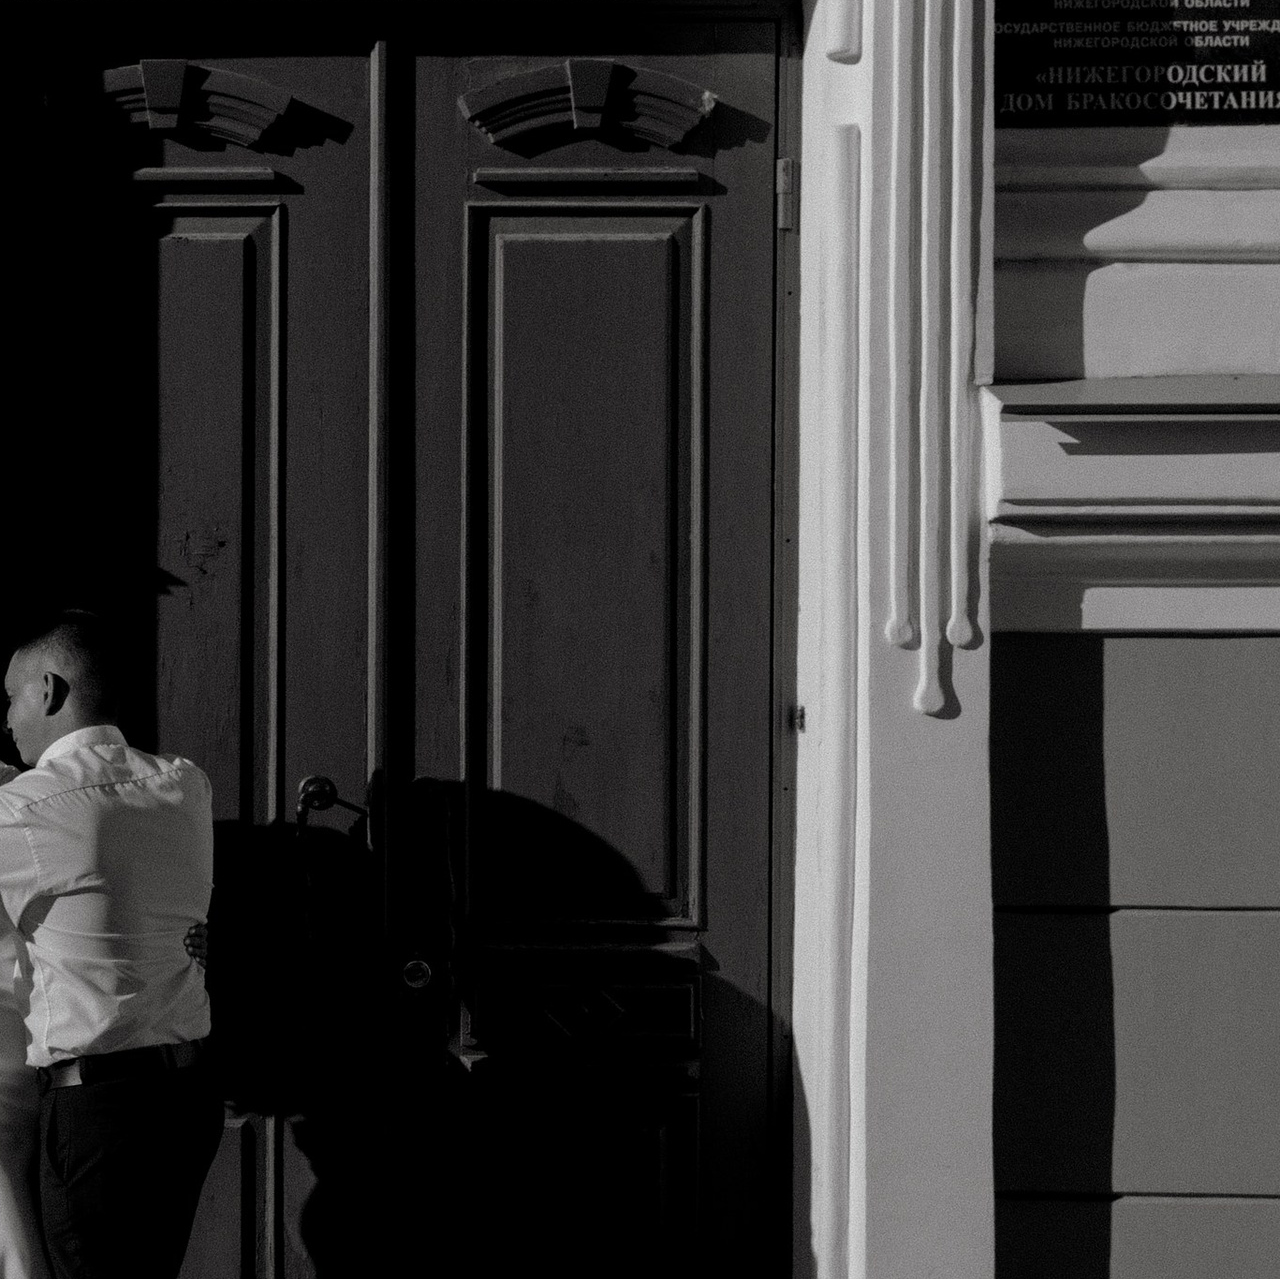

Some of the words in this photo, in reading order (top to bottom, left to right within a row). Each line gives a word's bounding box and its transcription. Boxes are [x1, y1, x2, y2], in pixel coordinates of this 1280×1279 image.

[995, 21, 1121, 35] ОСУДАРСТВЕННОЕ
[1127, 21, 1218, 34] БЮДЖЕТНОЕ
[1223, 20, 1280, 34] УЧРЕЖД
[1053, 35, 1178, 50] НИЖЕГОРОДСКОЙ
[1184, 35, 1250, 48] ОБЛАСТИ
[1000, 93, 1054, 114] ДОМ
